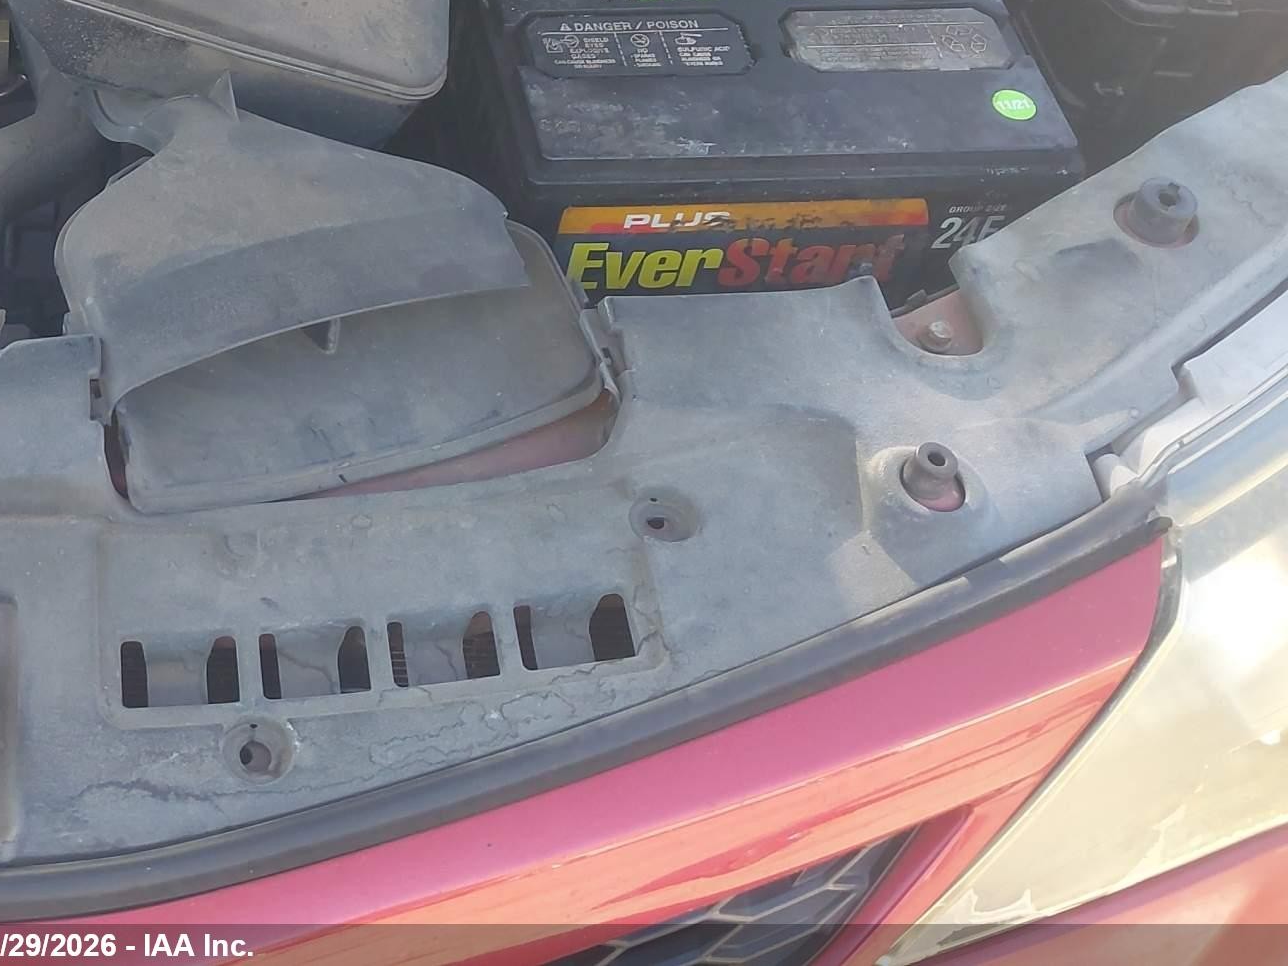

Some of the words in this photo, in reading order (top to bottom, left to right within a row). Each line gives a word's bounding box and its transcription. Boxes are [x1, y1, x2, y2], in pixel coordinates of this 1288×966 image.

[574, 22, 632, 31] DANGER
[647, 20, 700, 29] POISON
[624, 211, 730, 229] PLUS
[931, 215, 1006, 249] 24F
[567, 234, 905, 290] EverStart
